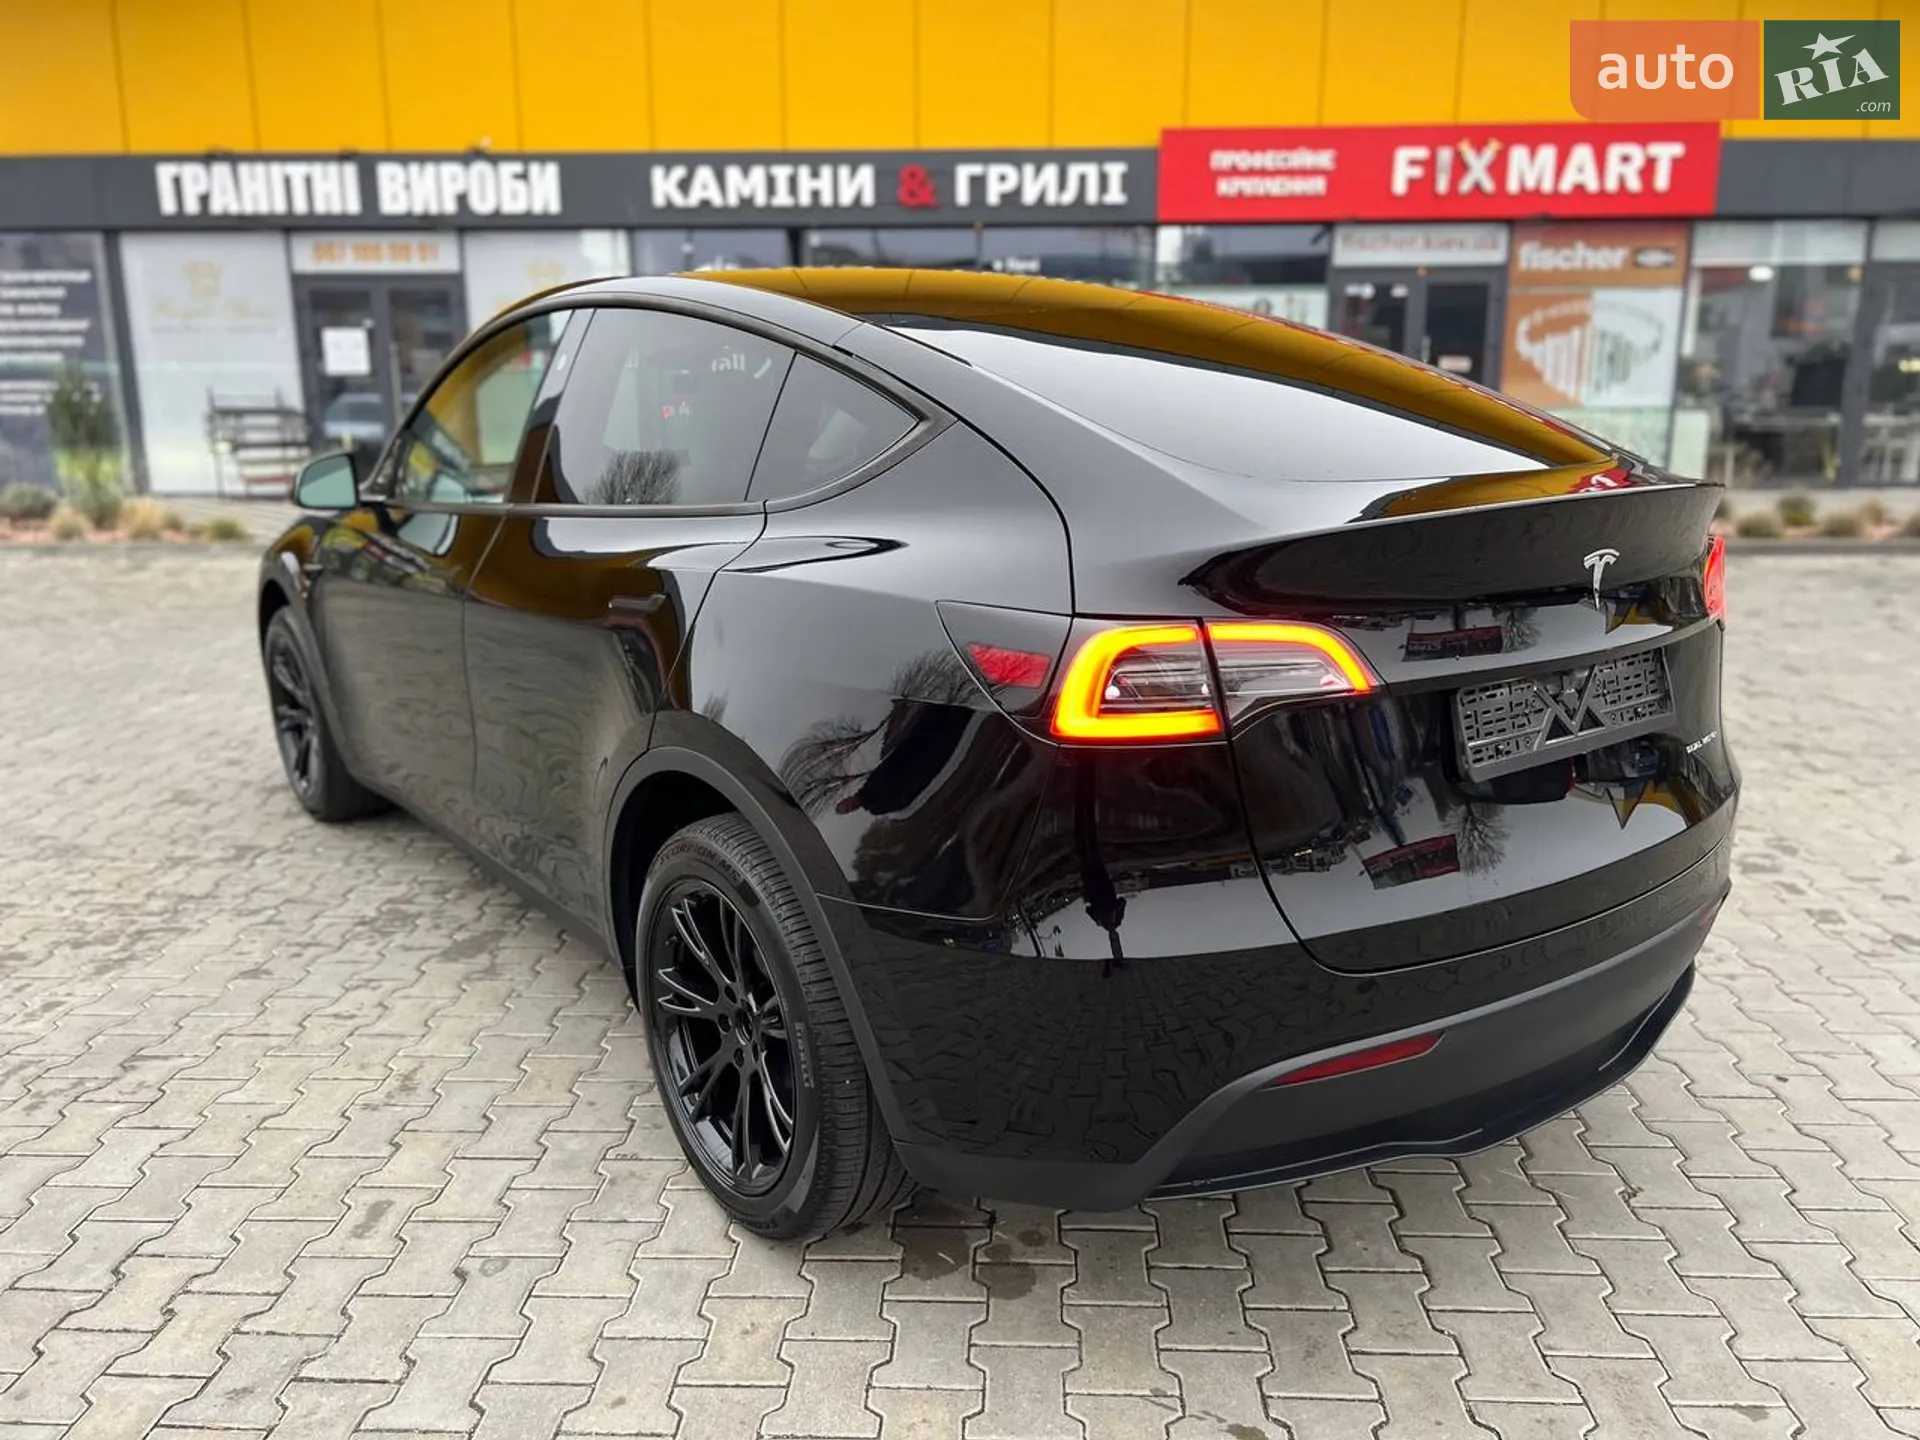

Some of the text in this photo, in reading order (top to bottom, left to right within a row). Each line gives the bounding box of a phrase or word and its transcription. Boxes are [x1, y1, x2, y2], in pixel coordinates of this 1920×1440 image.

[156, 161, 562, 216] ГРАНІТНІ ВИРОБИ
[650, 161, 1129, 208] КАМІНИ & ГРИЛІ
[1391, 140, 1685, 197] FIXMART
[1518, 240, 1629, 271] fischer
